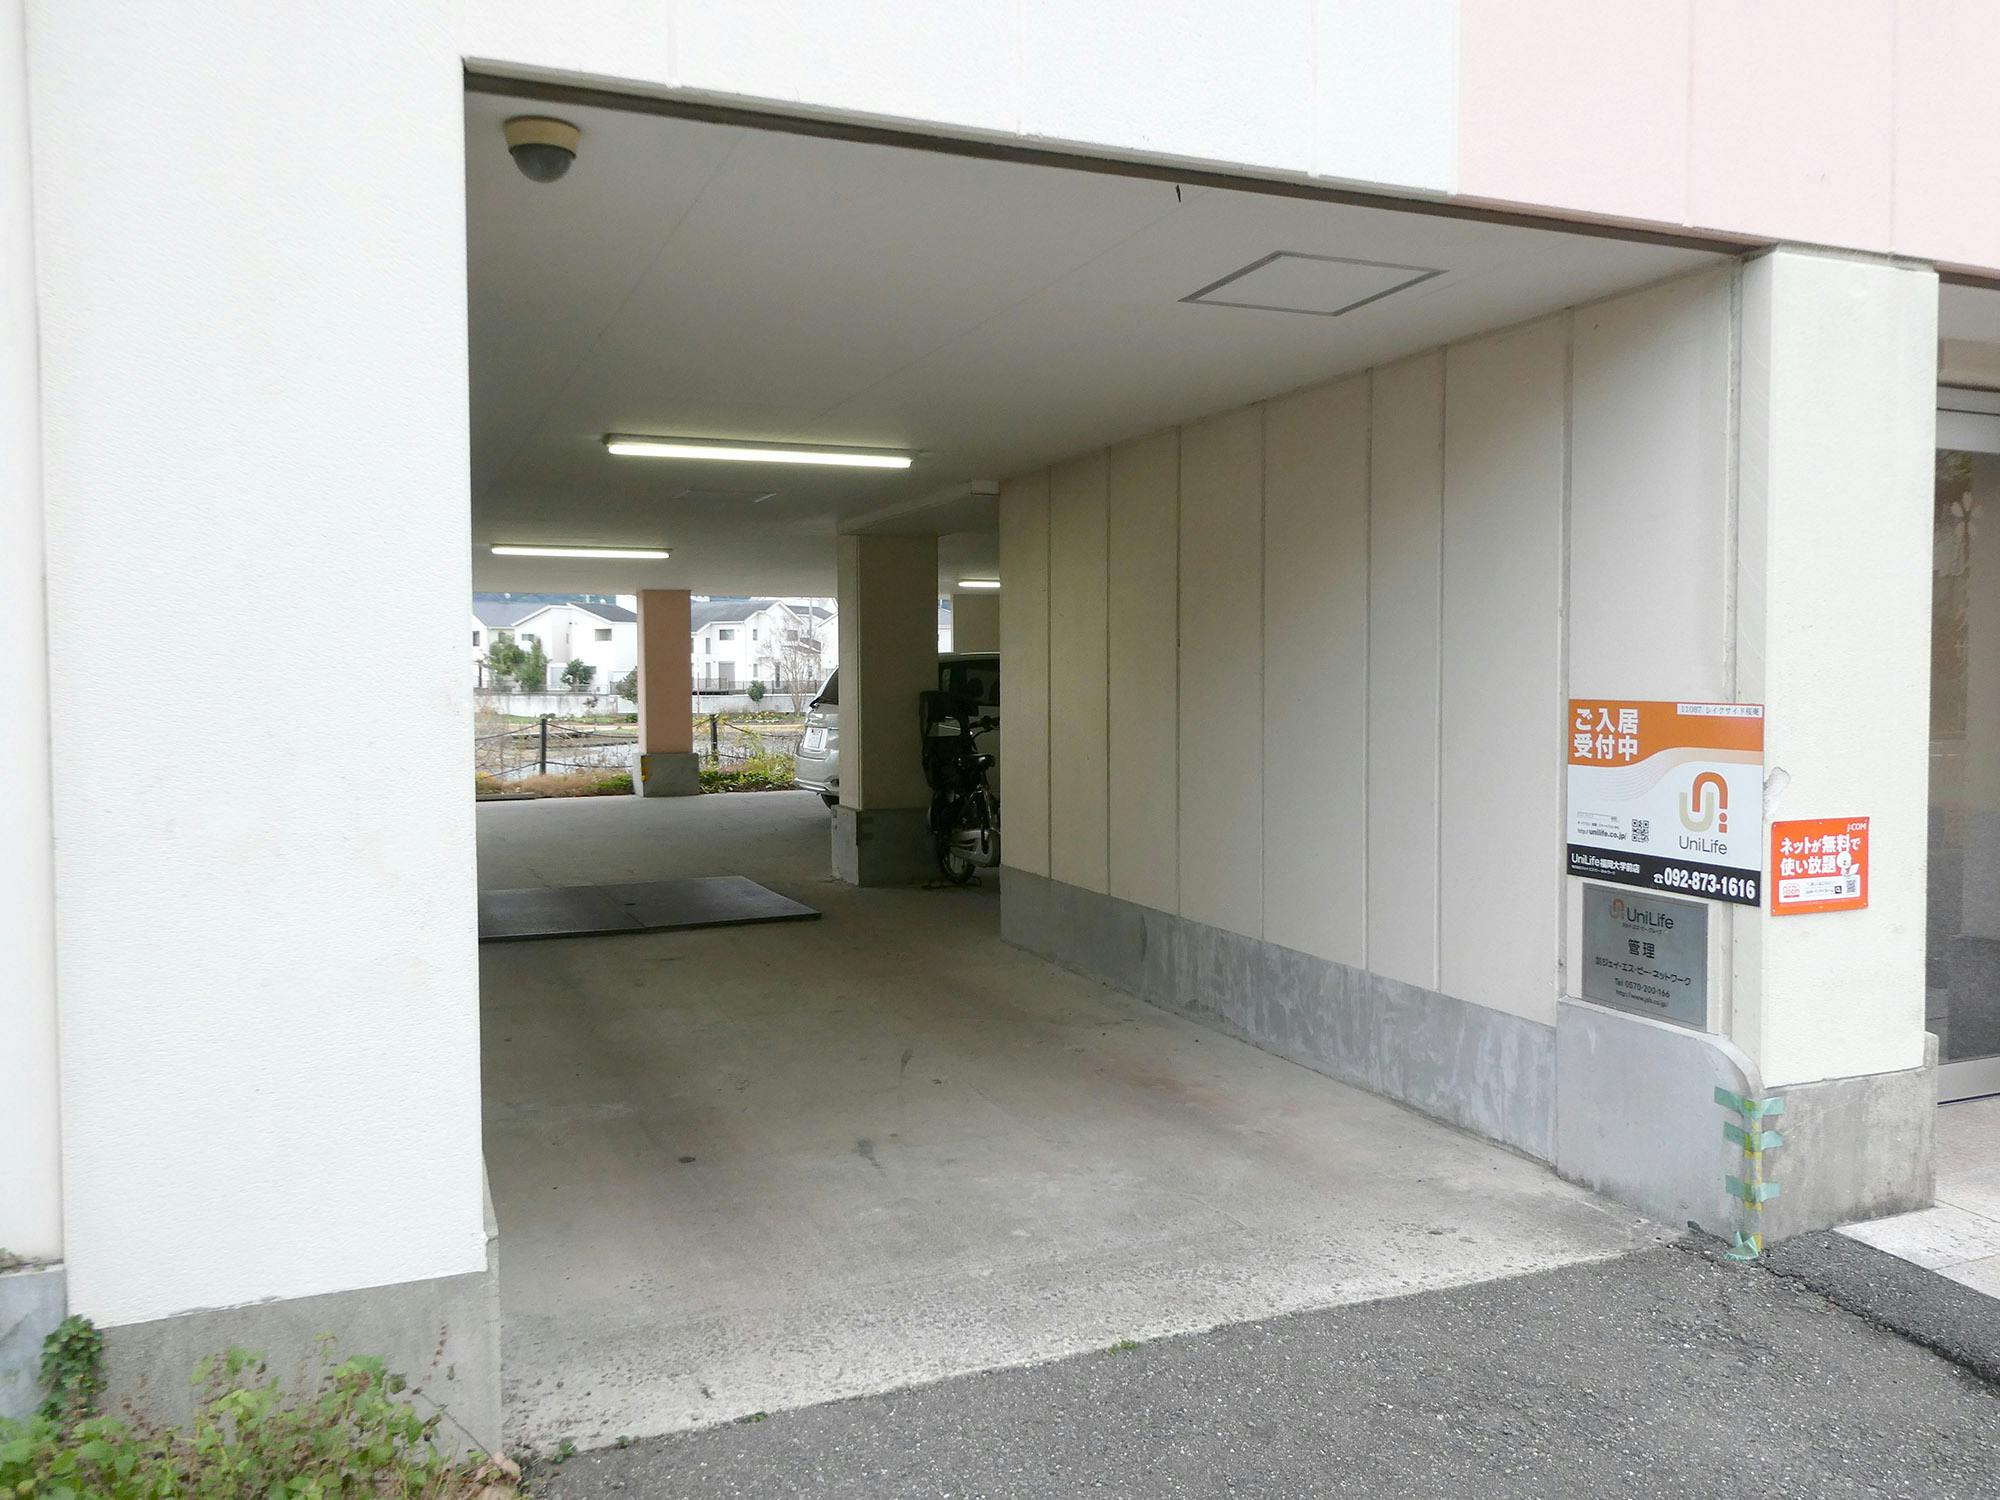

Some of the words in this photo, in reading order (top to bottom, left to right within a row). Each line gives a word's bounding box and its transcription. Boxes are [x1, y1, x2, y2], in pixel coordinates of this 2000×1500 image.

[1576, 708, 1639, 735] ご入居
[1574, 733, 1639, 761] 受付中
[1679, 835, 1727, 855] UniLife
[1780, 834, 1861, 855] ネットが無料で
[1780, 855, 1837, 876] 使い放題
[1664, 867, 1756, 899] 092-873-1616
[1627, 907, 1674, 929] UniLife
[1628, 938, 1655, 959] 管理
